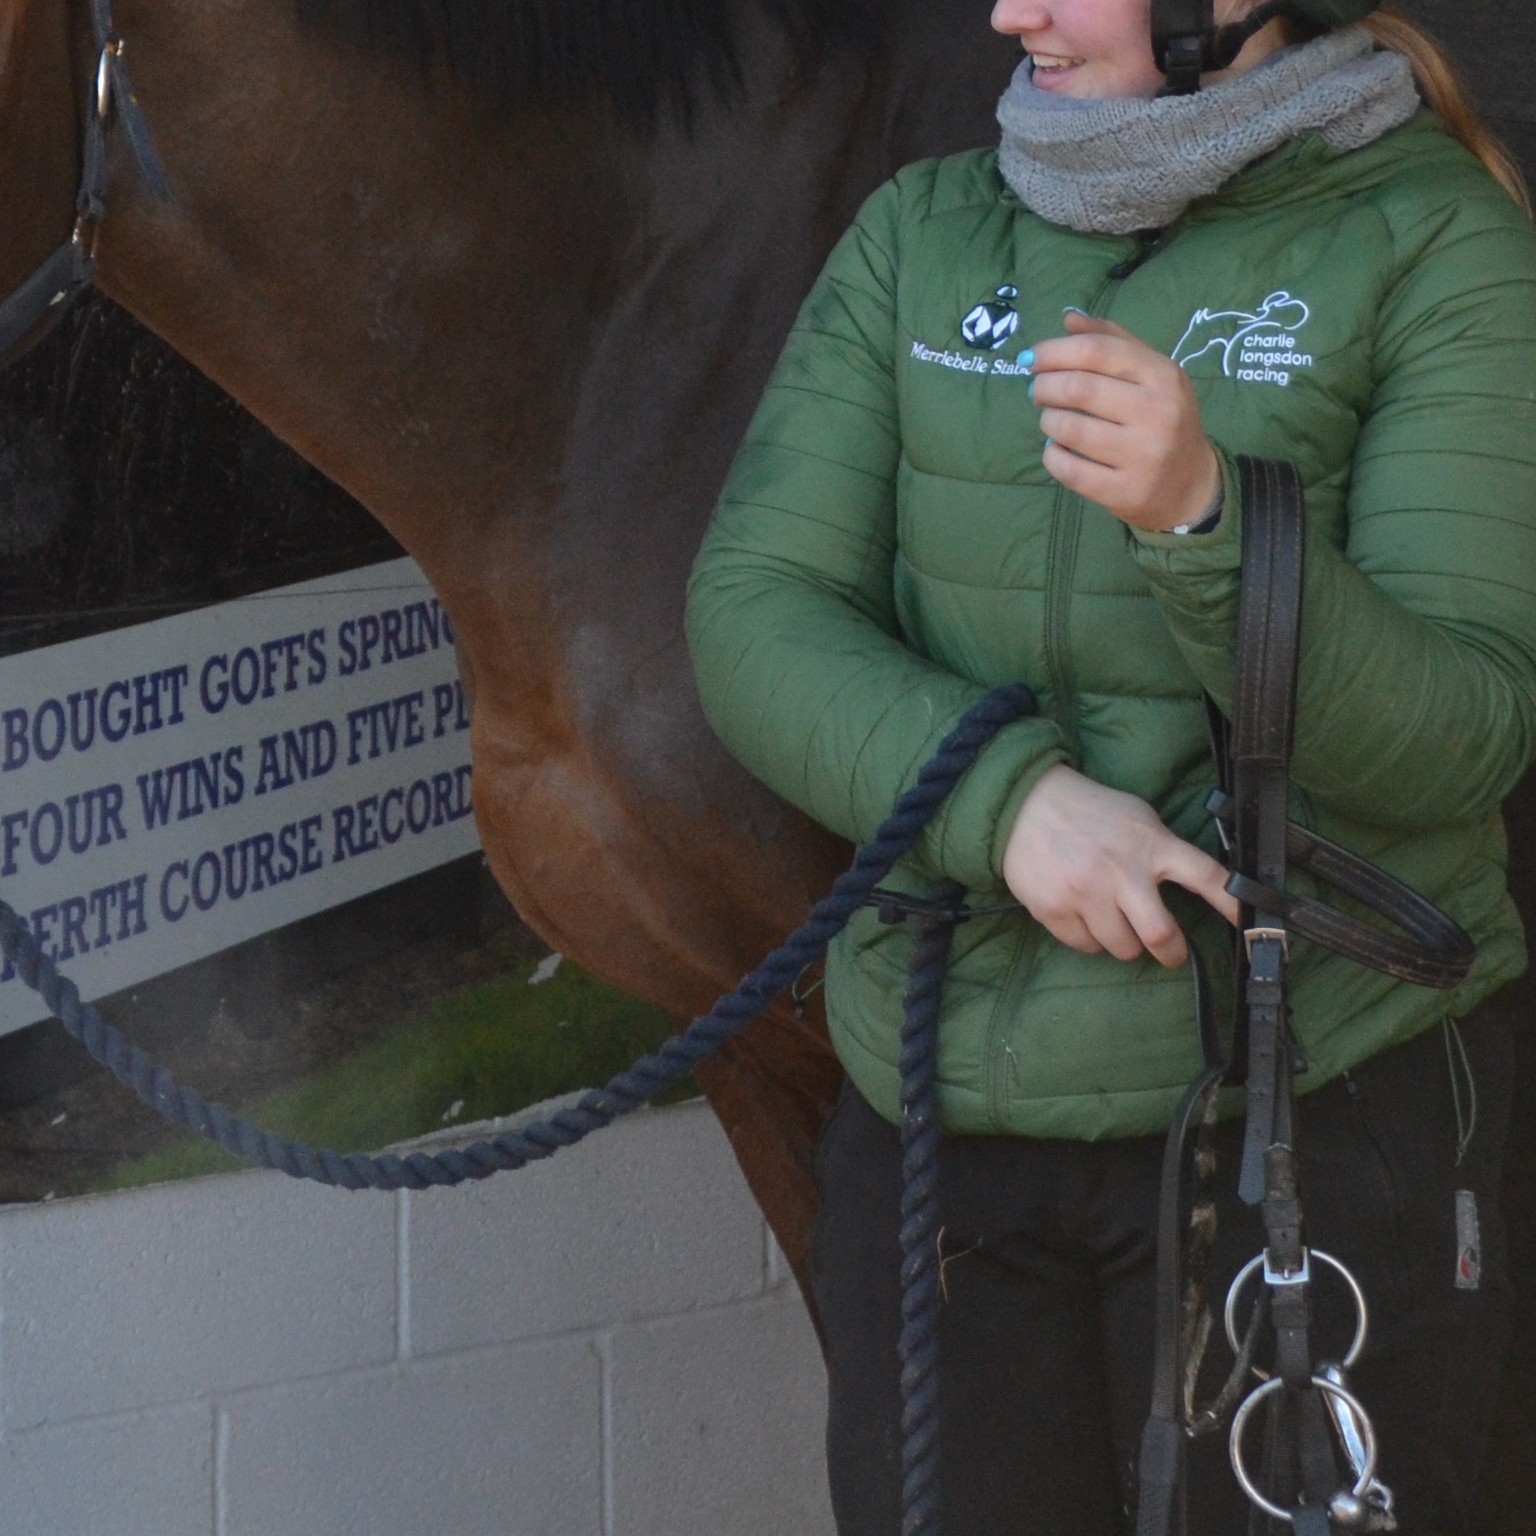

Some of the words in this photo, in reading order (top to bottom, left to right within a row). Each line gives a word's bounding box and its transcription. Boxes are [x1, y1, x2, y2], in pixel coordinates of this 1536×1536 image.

[1243, 332, 1296, 349] charlie
[910, 341, 988, 374] Merriebelle
[1239, 348, 1312, 367] longsdon
[1236, 367, 1289, 387] racing
[1, 664, 188, 772] BOUGHT
[199, 627, 325, 713] GOFFS
[1, 782, 127, 877] FOUR
[136, 745, 245, 831] WINS
[255, 719, 337, 797] AND
[347, 692, 424, 766] FIVE
[160, 816, 323, 923] COURSE
